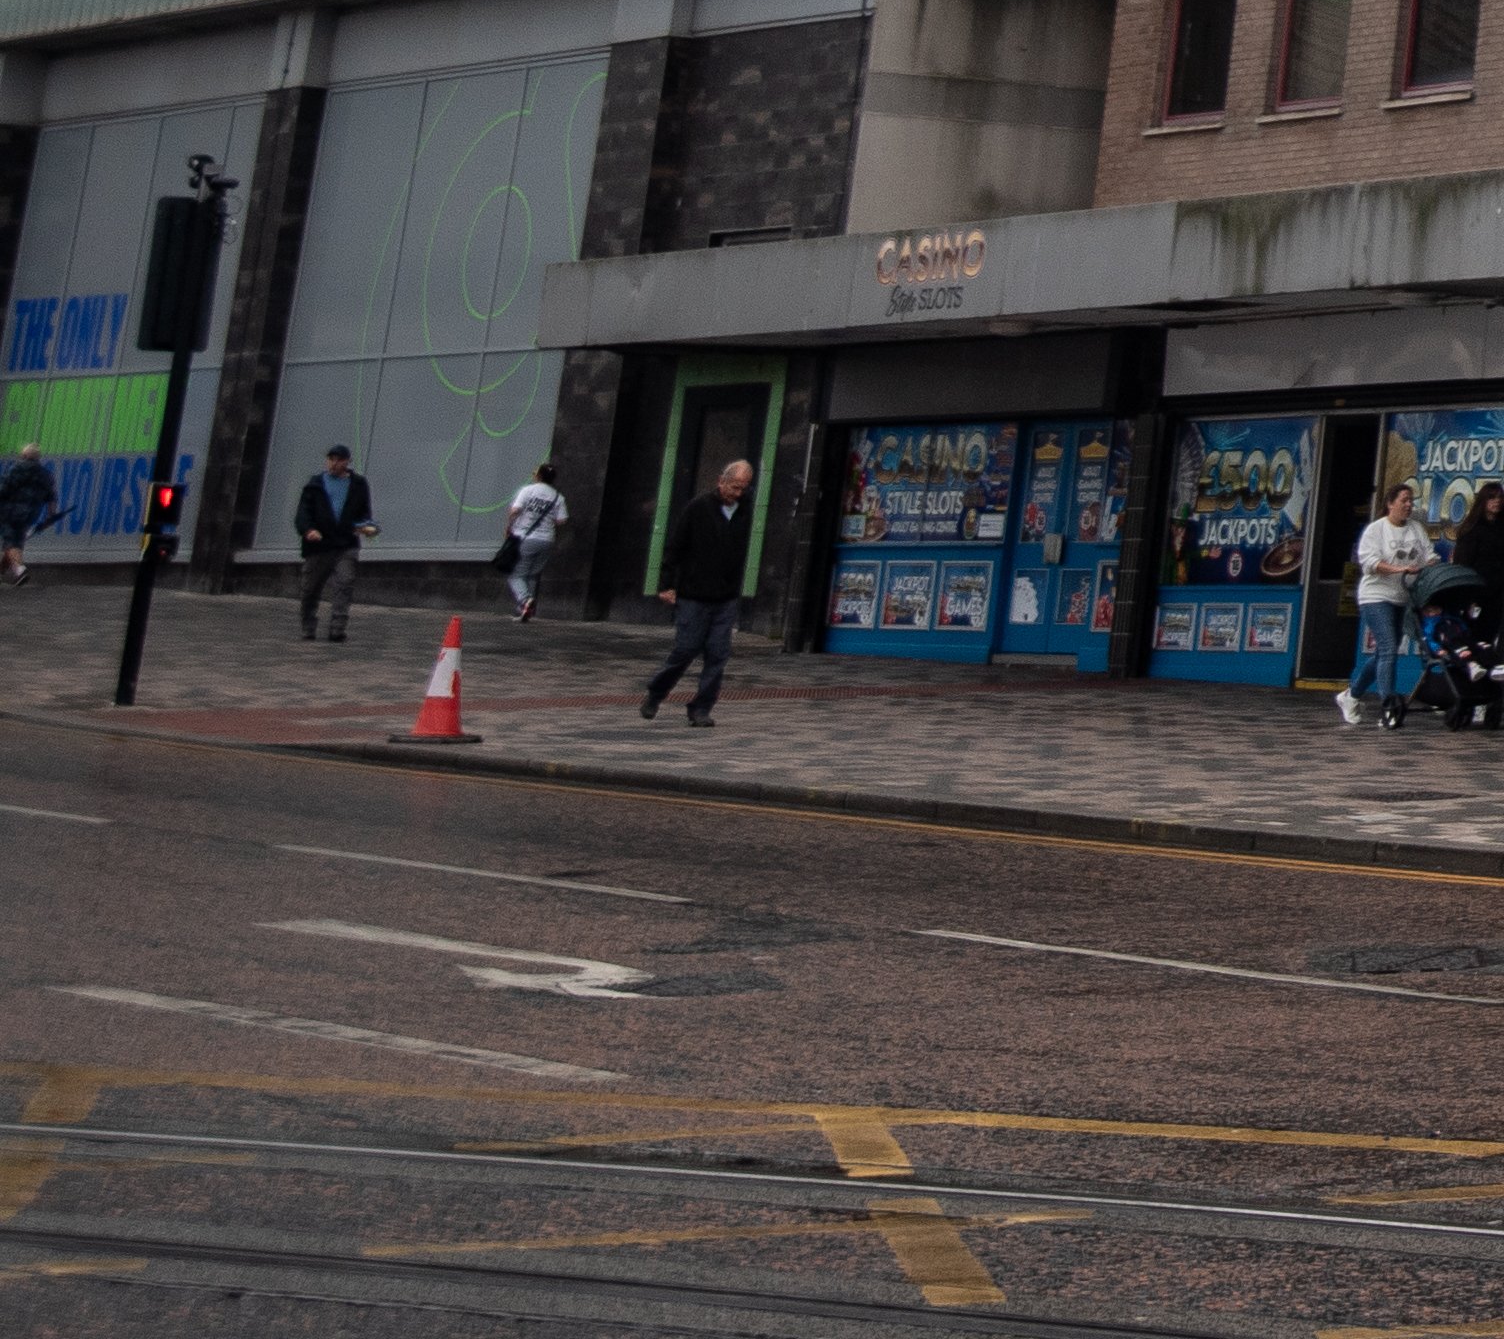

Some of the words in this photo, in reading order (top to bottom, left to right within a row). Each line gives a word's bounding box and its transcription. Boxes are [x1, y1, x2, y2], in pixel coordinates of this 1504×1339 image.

[877, 229, 985, 284] CASINO
[917, 286, 964, 311] SLOTS
[8, 297, 59, 371] THE
[56, 293, 128, 370] ONLY
[874, 433, 987, 484] CASINO
[1194, 447, 1295, 513] £500
[885, 491, 924, 514] STYLE
[925, 491, 964, 514] SLOTS
[1199, 518, 1278, 545] JACKPOTS
